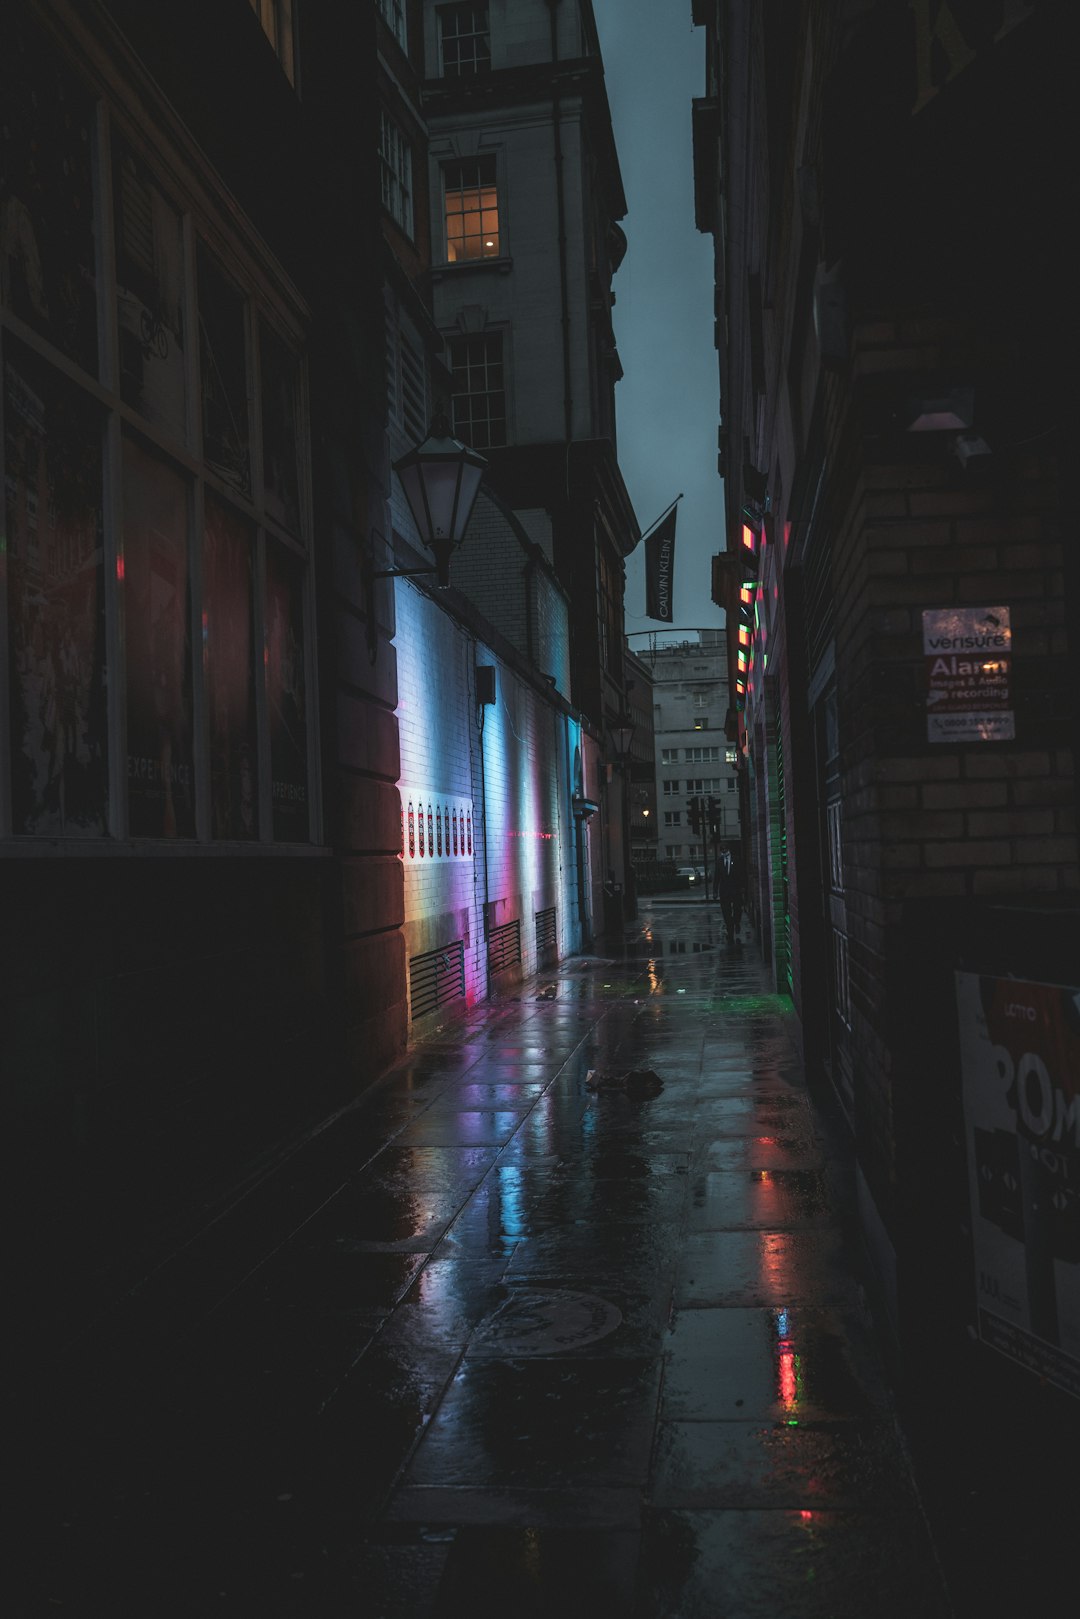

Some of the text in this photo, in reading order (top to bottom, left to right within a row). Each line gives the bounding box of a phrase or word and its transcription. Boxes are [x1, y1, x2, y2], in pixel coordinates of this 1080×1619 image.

[659, 540, 671, 617] CALVIN KLEIN
[928, 635, 1005, 649] verisure
[930, 655, 1008, 676] Alarm
[930, 679, 965, 689] Images
[979, 675, 1008, 686] Audio
[951, 687, 1009, 699] recording
[1004, 1002, 1037, 1021] LOTTO
